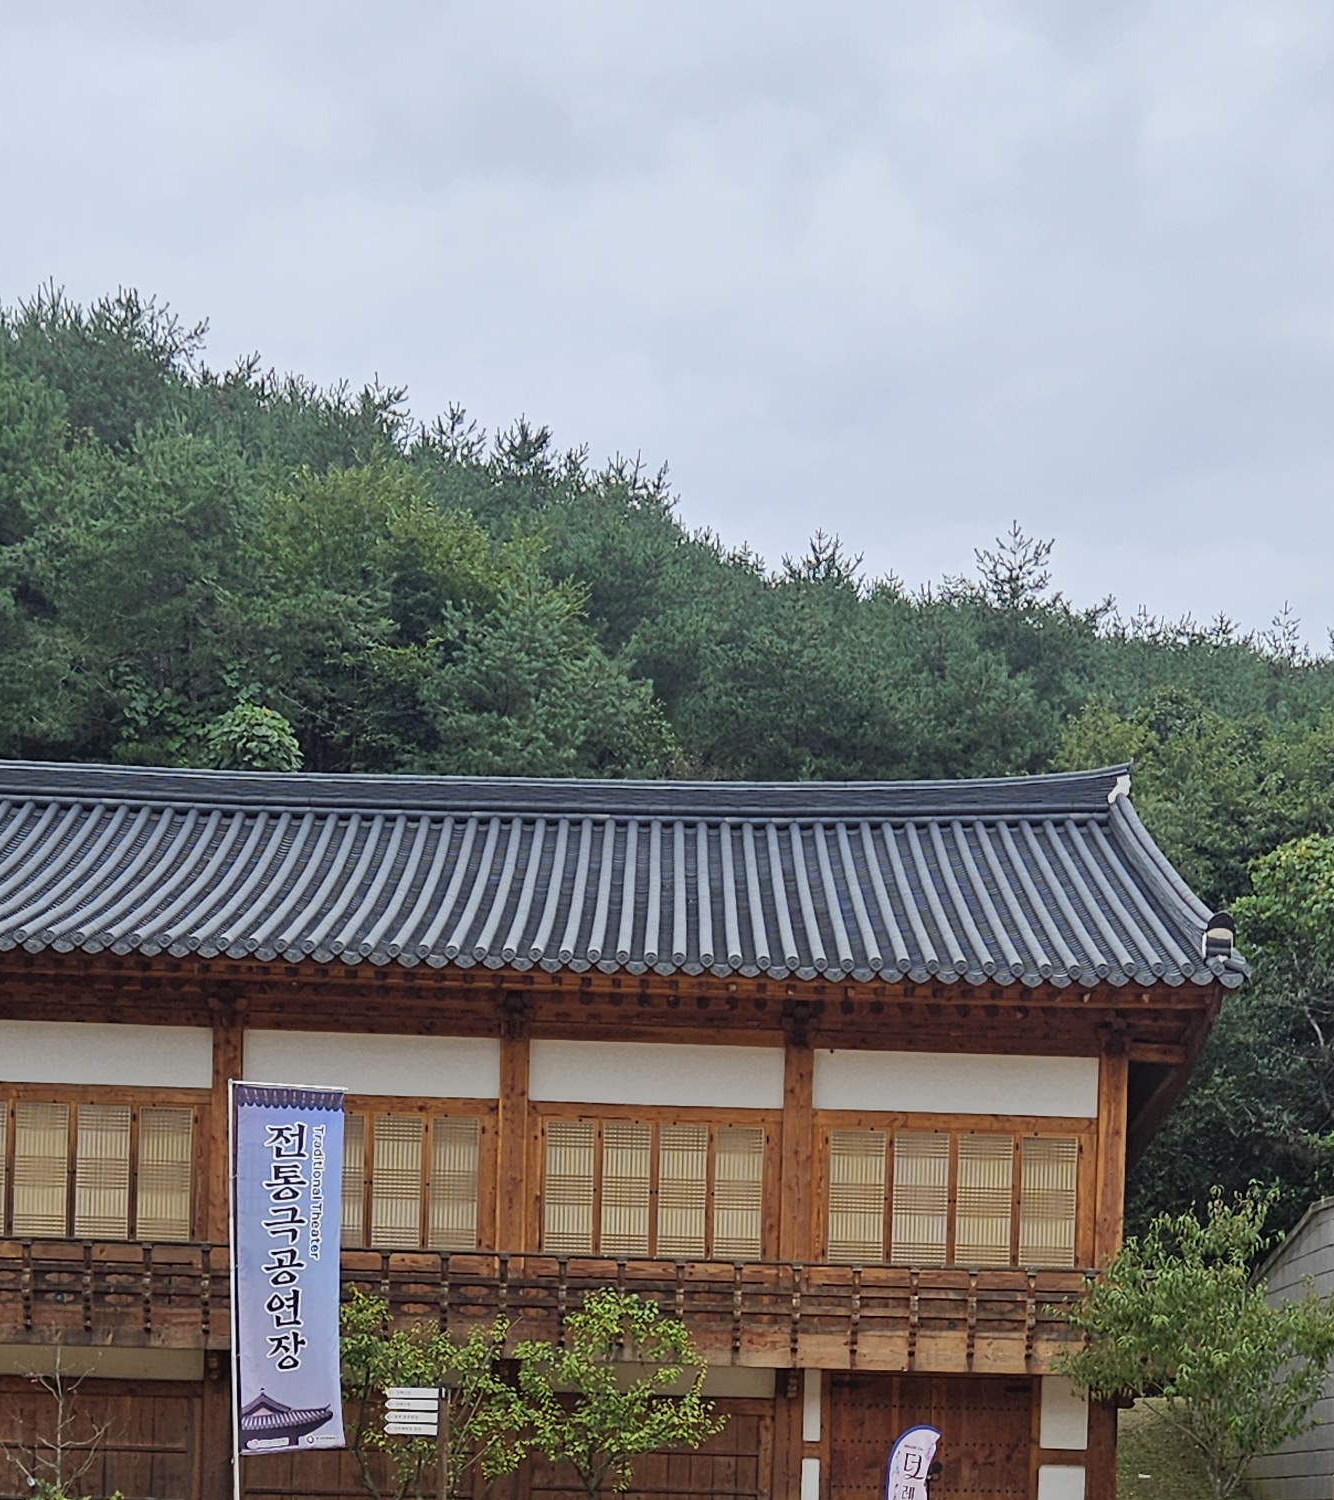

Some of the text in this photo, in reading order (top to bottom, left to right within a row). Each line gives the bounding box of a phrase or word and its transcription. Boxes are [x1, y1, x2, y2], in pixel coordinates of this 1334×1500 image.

[262, 1122, 309, 1372] 전통극공연장
[310, 1126, 325, 1260] Traditional Theater
